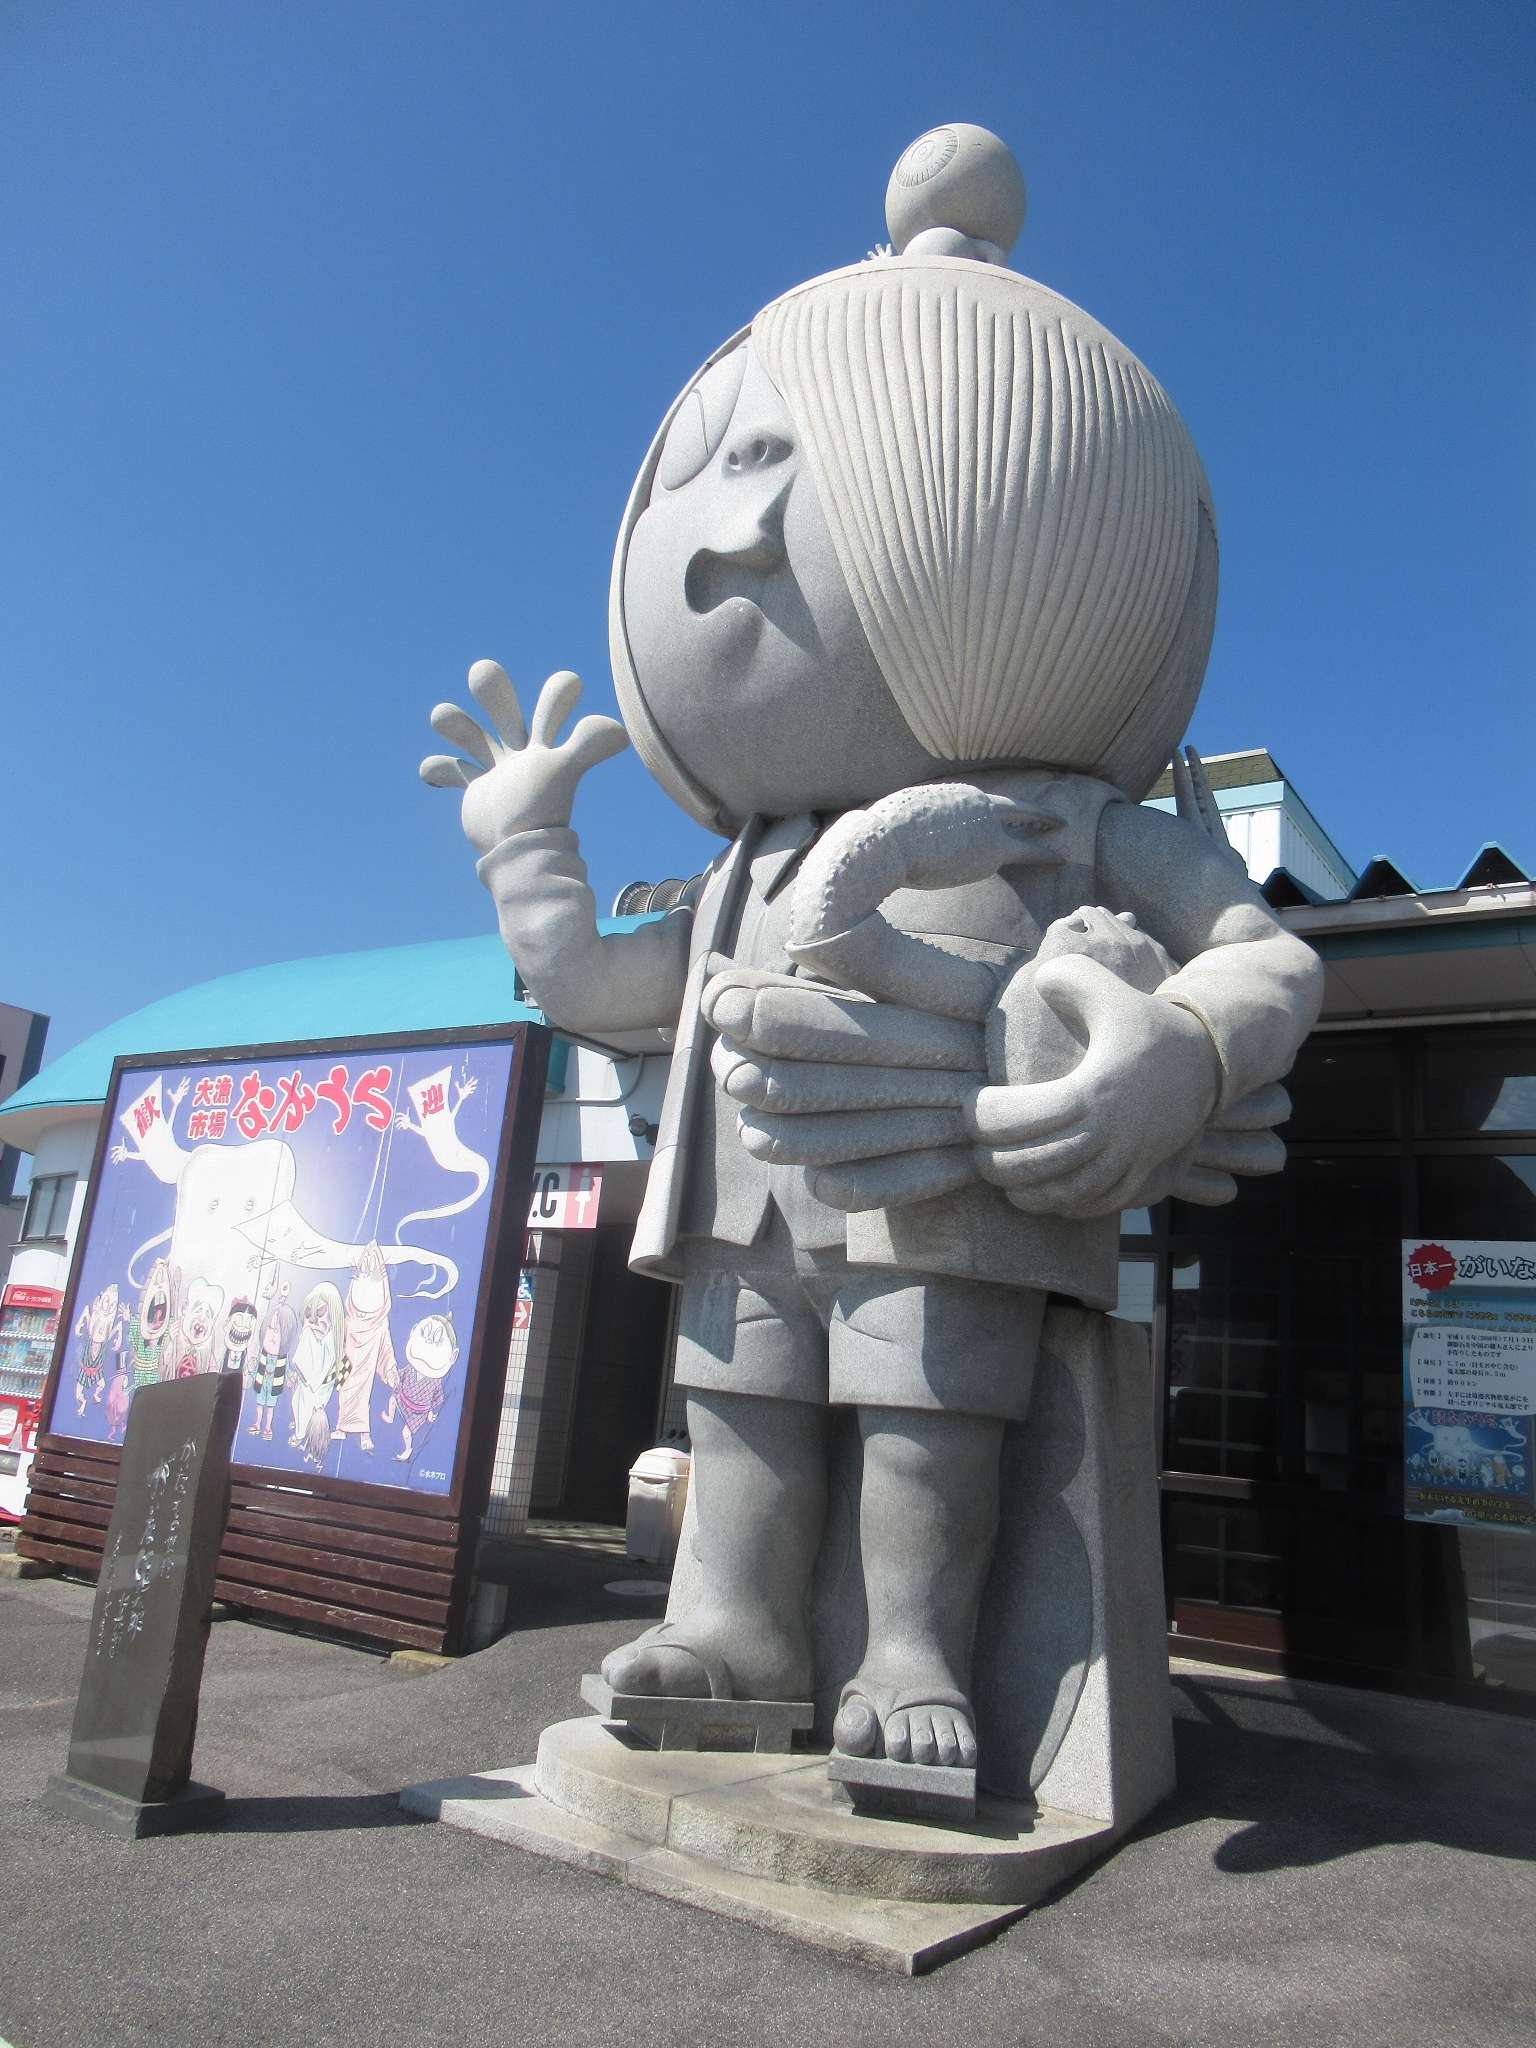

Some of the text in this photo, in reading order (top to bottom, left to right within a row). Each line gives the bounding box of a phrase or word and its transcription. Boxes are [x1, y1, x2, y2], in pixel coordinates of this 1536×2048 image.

[193, 1076, 233, 1108] 大漁
[232, 1064, 393, 1139] なかうら
[420, 1083, 447, 1119] 迎
[187, 1110, 227, 1140] 市場
[1408, 1261, 1452, 1277] 日本一
[1458, 1255, 1536, 1280] がいな
